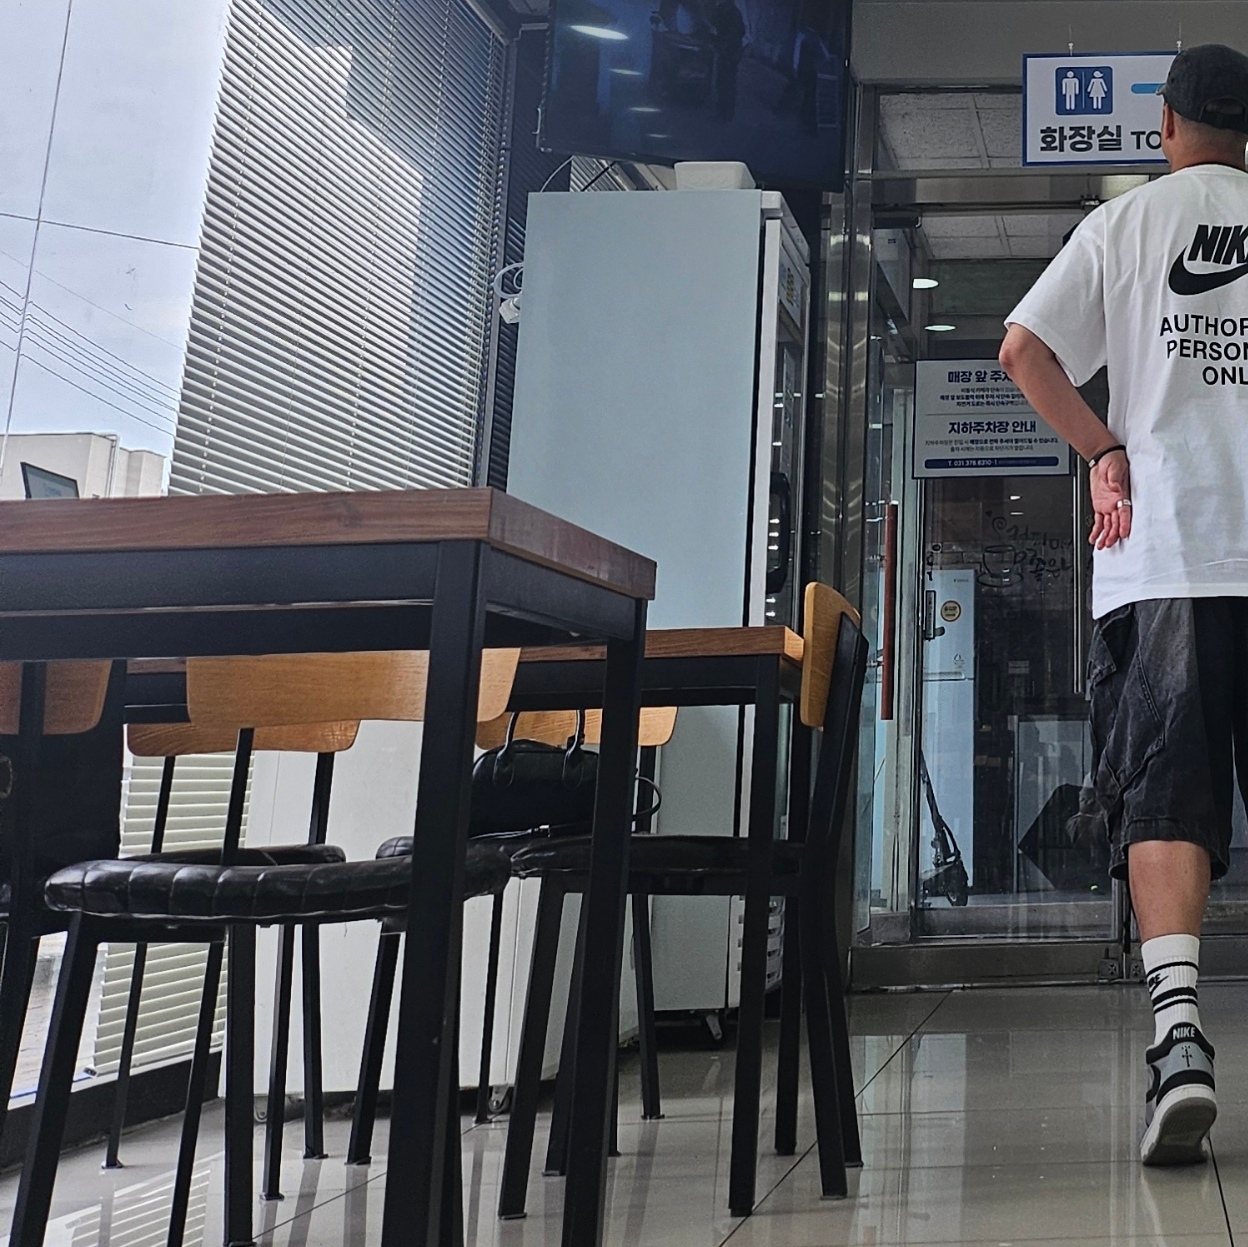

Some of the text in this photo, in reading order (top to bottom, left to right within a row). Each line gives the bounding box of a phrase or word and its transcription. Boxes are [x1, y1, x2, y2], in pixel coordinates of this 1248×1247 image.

[1040, 125, 1122, 152] 화장실
[947, 370, 972, 383] 매장
[975, 370, 987, 383] 앞
[948, 420, 1037, 434] 지하주차장 안내
[1172, 1026, 1196, 1040] NIKE
